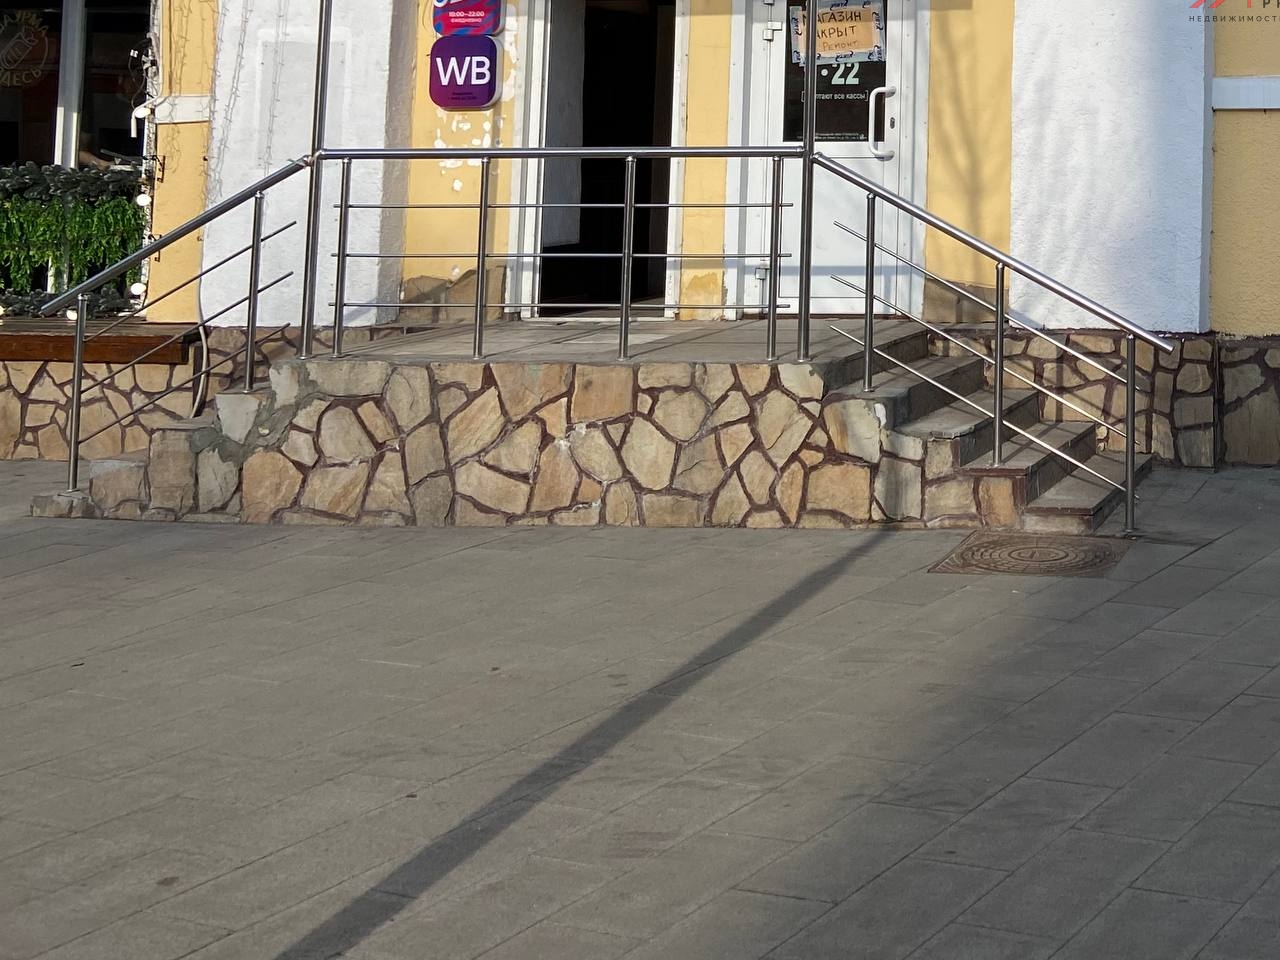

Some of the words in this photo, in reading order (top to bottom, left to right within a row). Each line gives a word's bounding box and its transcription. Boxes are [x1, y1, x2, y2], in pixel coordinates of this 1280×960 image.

[816, 25, 856, 39] КРЫТ
[0, 66, 42, 88] ДЕСЬ
[435, 56, 491, 86] WB
